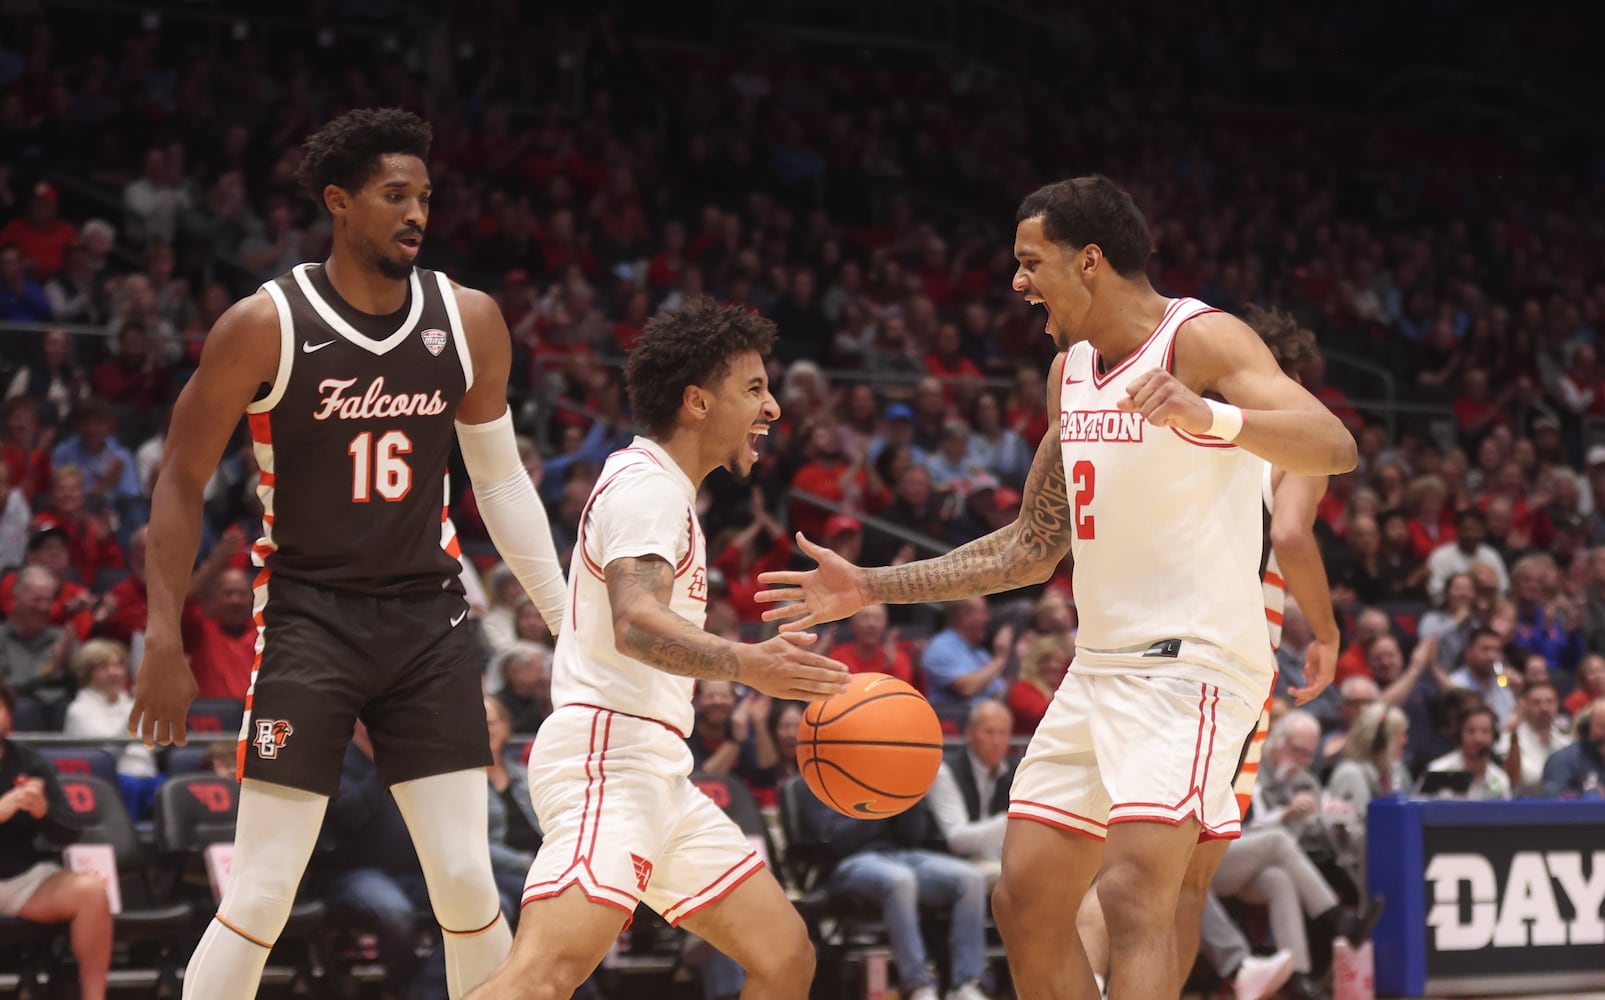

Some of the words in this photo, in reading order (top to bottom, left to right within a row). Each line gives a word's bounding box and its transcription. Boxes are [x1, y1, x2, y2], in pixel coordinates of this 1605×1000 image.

[313, 375, 448, 421] Falcons
[348, 430, 413, 502] 16
[1072, 460, 1096, 540] 2
[1425, 851, 1605, 951] DAY
